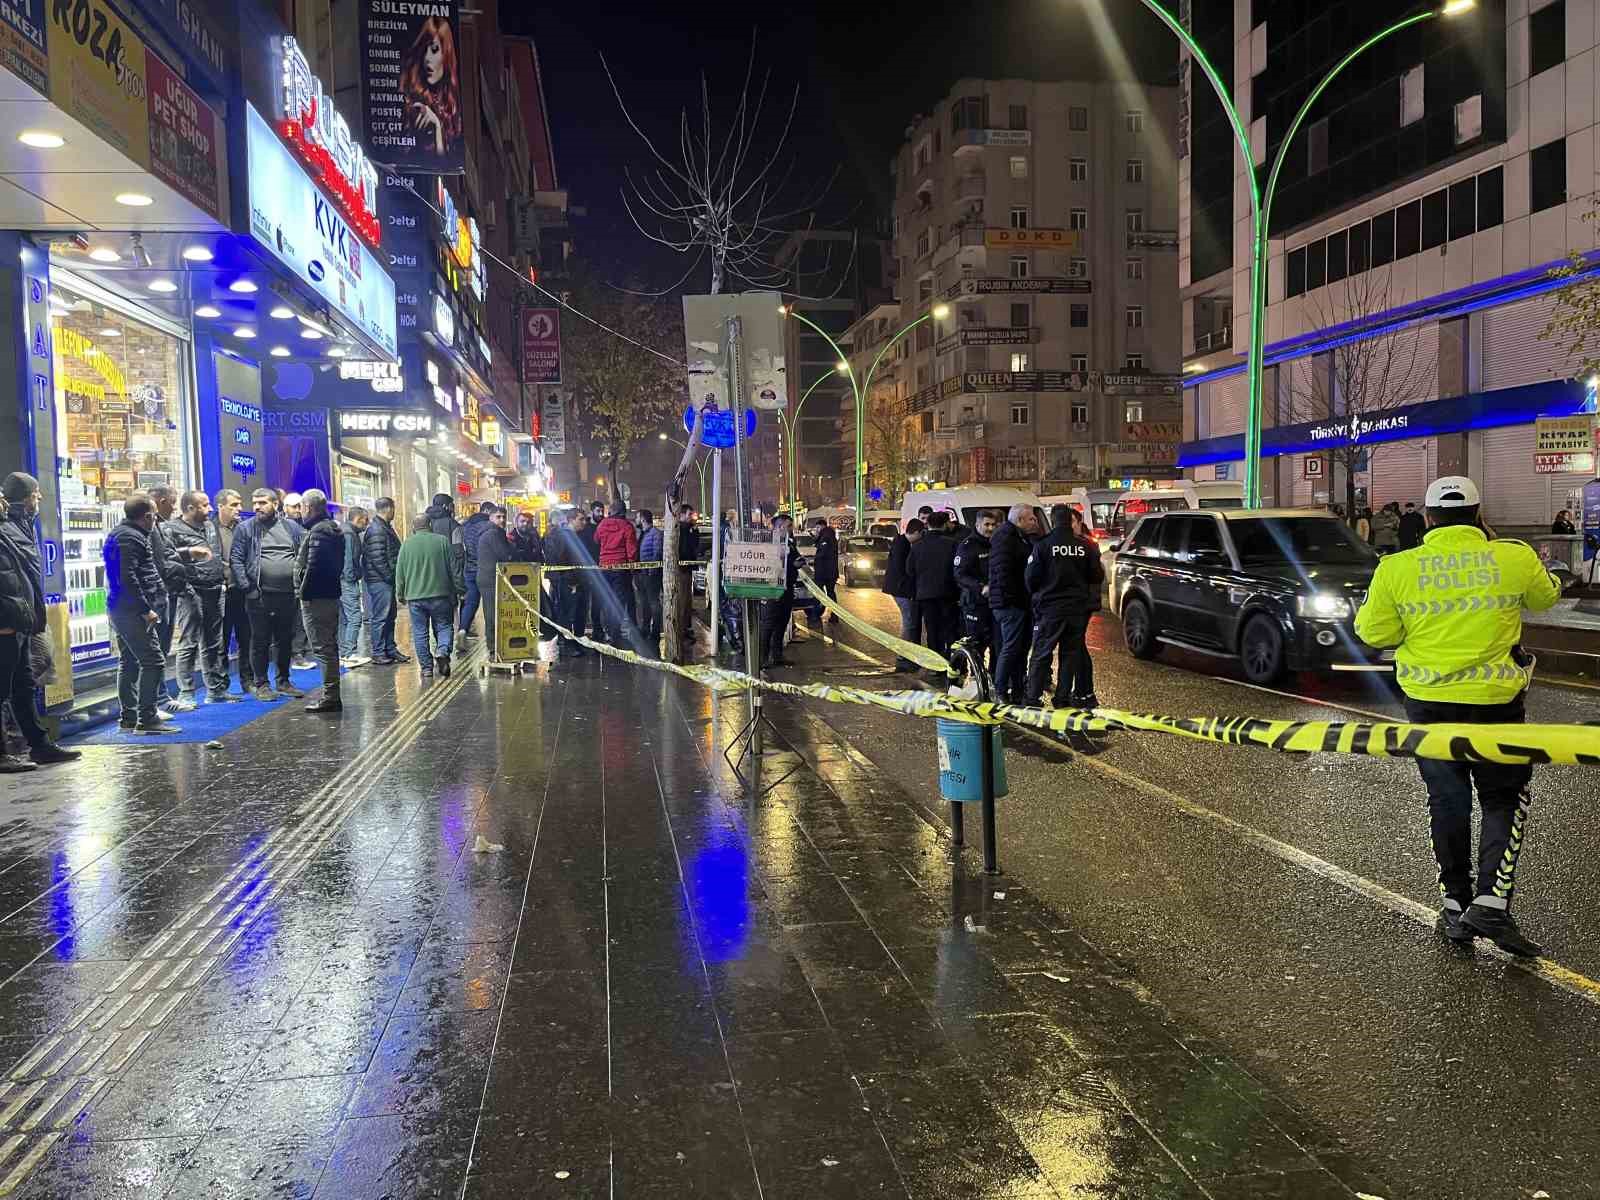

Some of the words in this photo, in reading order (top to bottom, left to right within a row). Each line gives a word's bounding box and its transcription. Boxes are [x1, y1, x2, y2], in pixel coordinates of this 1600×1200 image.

[372, 0, 450, 17] SÜLEYMAN
[368, 20, 408, 31] BREZİLYA
[370, 77, 398, 88] KESİM
[166, 78, 198, 123] UĞUR
[153, 91, 178, 130] PET
[180, 117, 210, 155] SHOP
[313, 190, 348, 263] KVK
[397, 294, 417, 305] elta
[967, 373, 1013, 385] QUEEN
[1105, 375, 1142, 385] QUEEN
[342, 414, 391, 431] MERT
[393, 414, 432, 431] GSM
[1310, 460, 1318, 471] D
[740, 549, 766, 560] UĞUR
[1417, 551, 1496, 574] TRAFİK
[733, 564, 772, 574] PETSHOP
